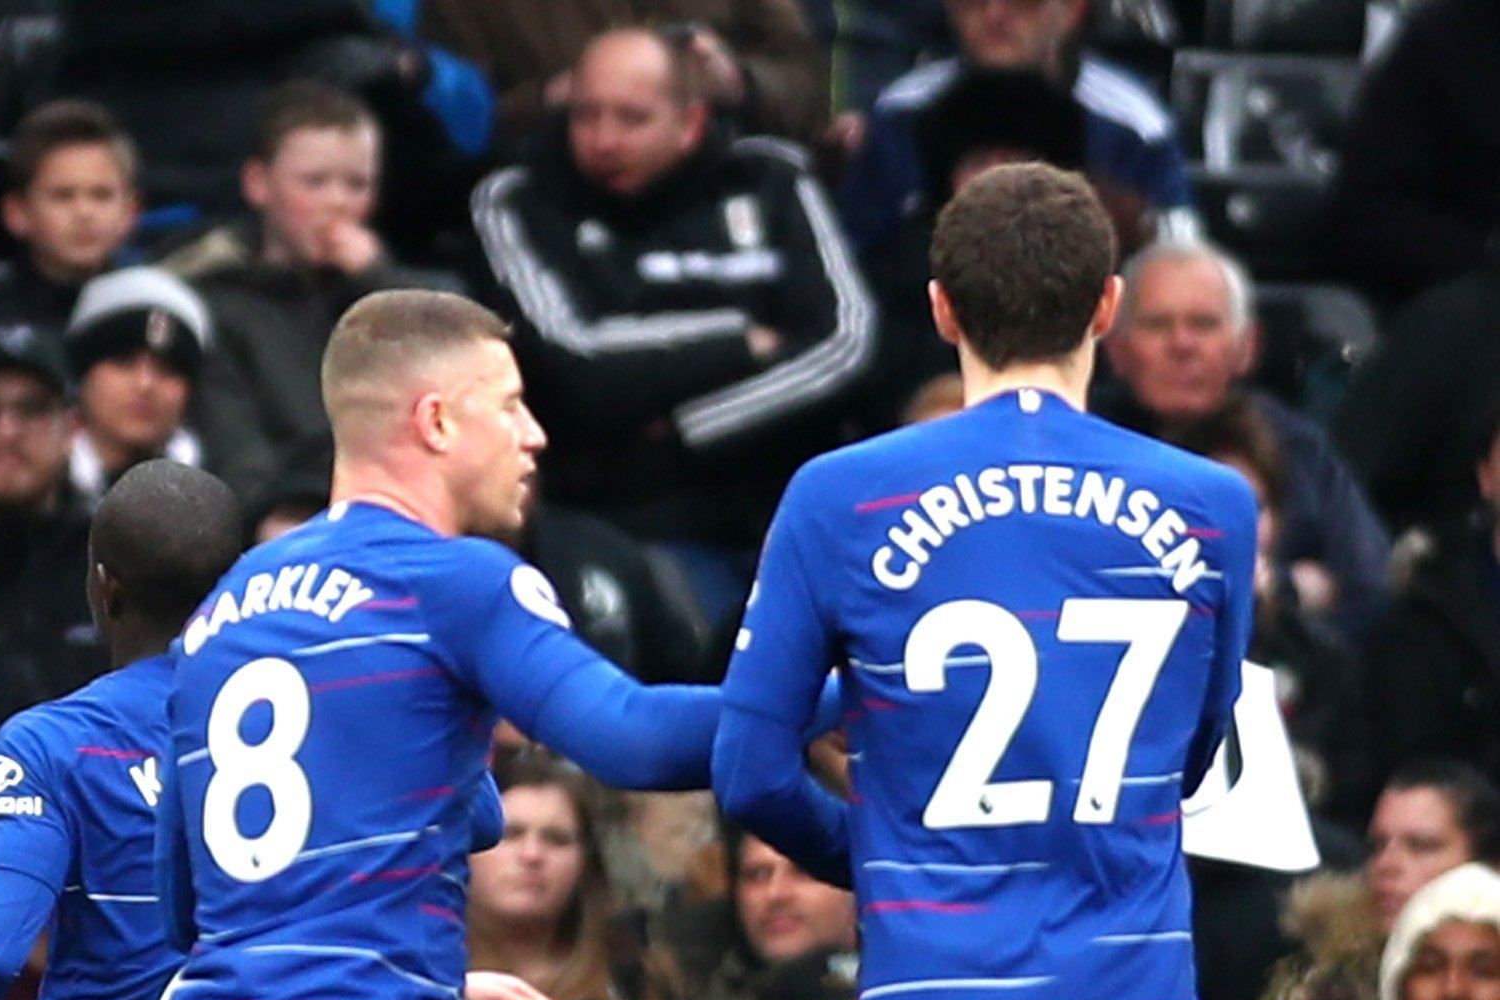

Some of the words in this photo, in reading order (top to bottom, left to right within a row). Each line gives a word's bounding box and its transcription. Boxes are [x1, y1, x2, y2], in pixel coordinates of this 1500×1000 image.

[870, 464, 1207, 593] CHRISTENSEN
[203, 656, 312, 883] 8
[903, 597, 1190, 830] 27
